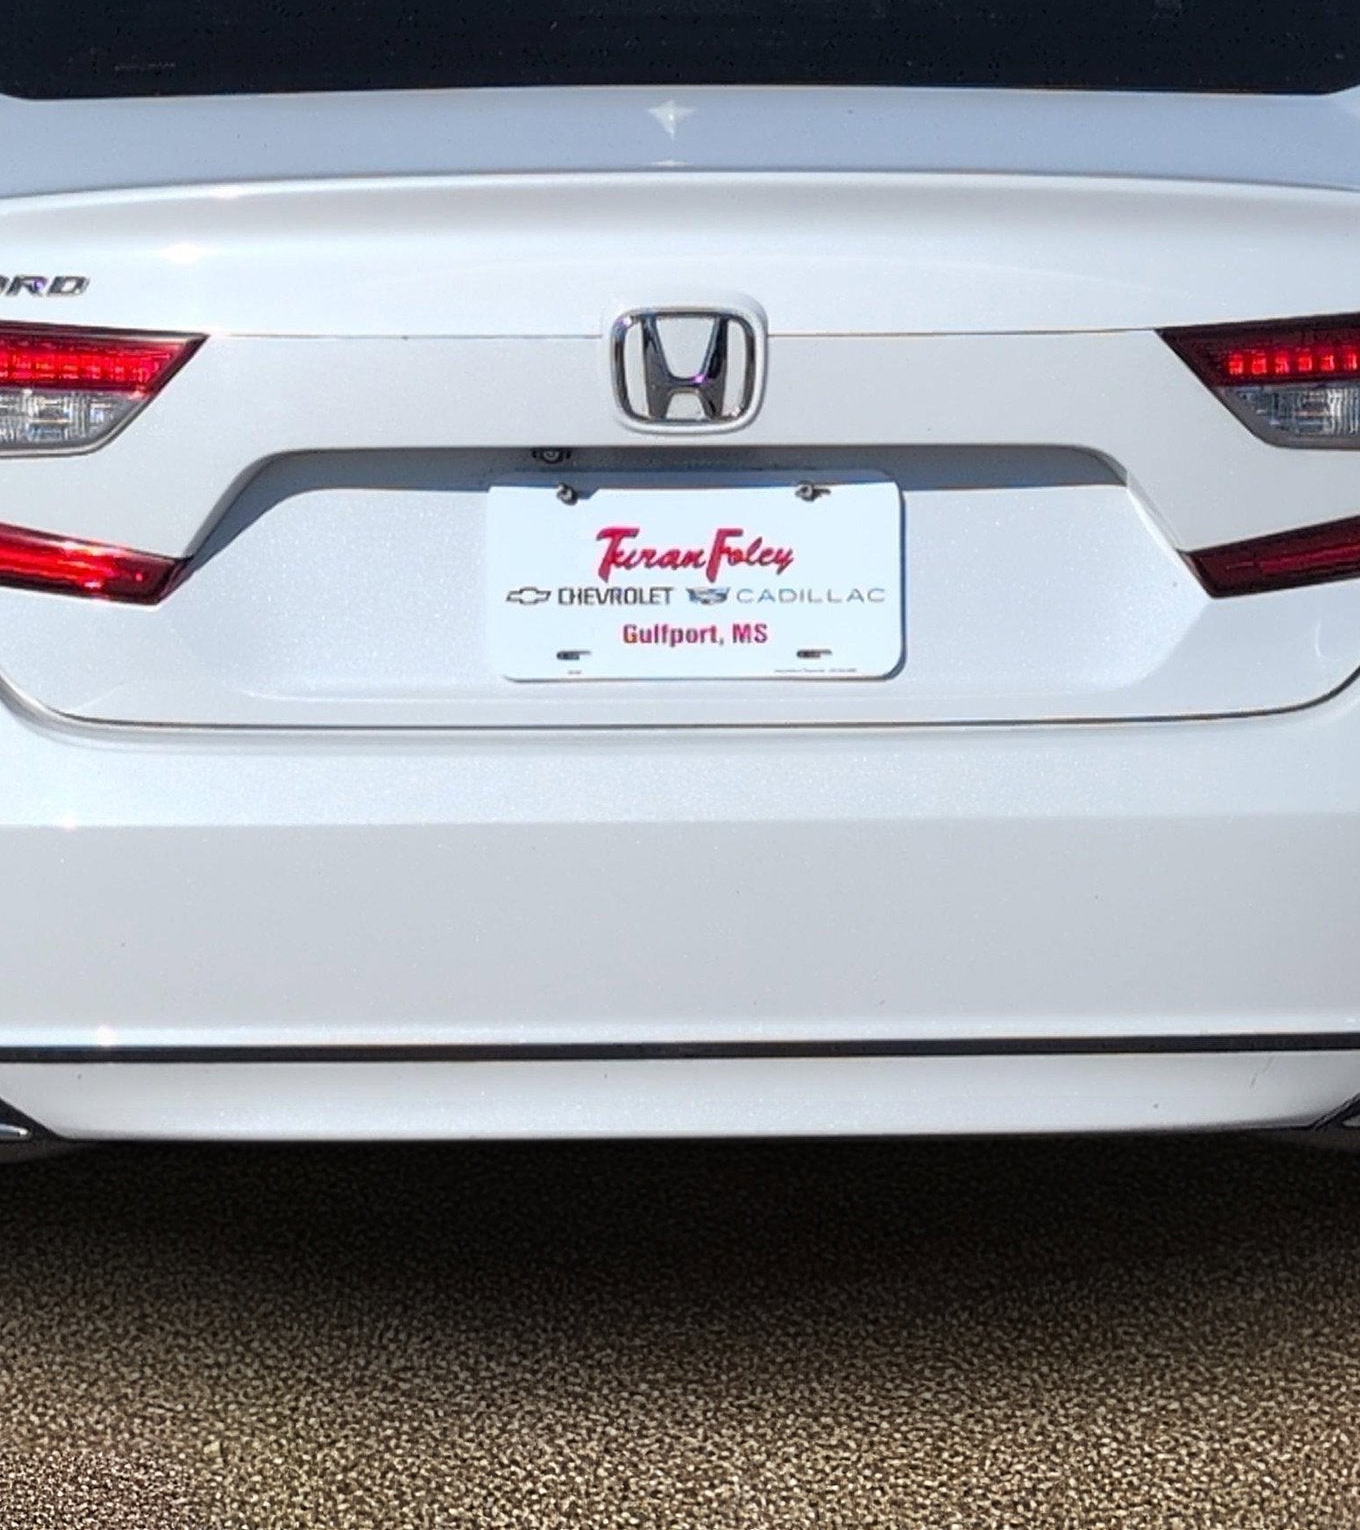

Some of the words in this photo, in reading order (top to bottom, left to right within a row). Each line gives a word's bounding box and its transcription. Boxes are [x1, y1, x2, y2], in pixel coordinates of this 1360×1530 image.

[558, 586, 673, 606] CHEVROLET
[736, 587, 886, 604] CADILLAC
[623, 623, 724, 647] Gulfport,
[731, 623, 768, 644] MS
